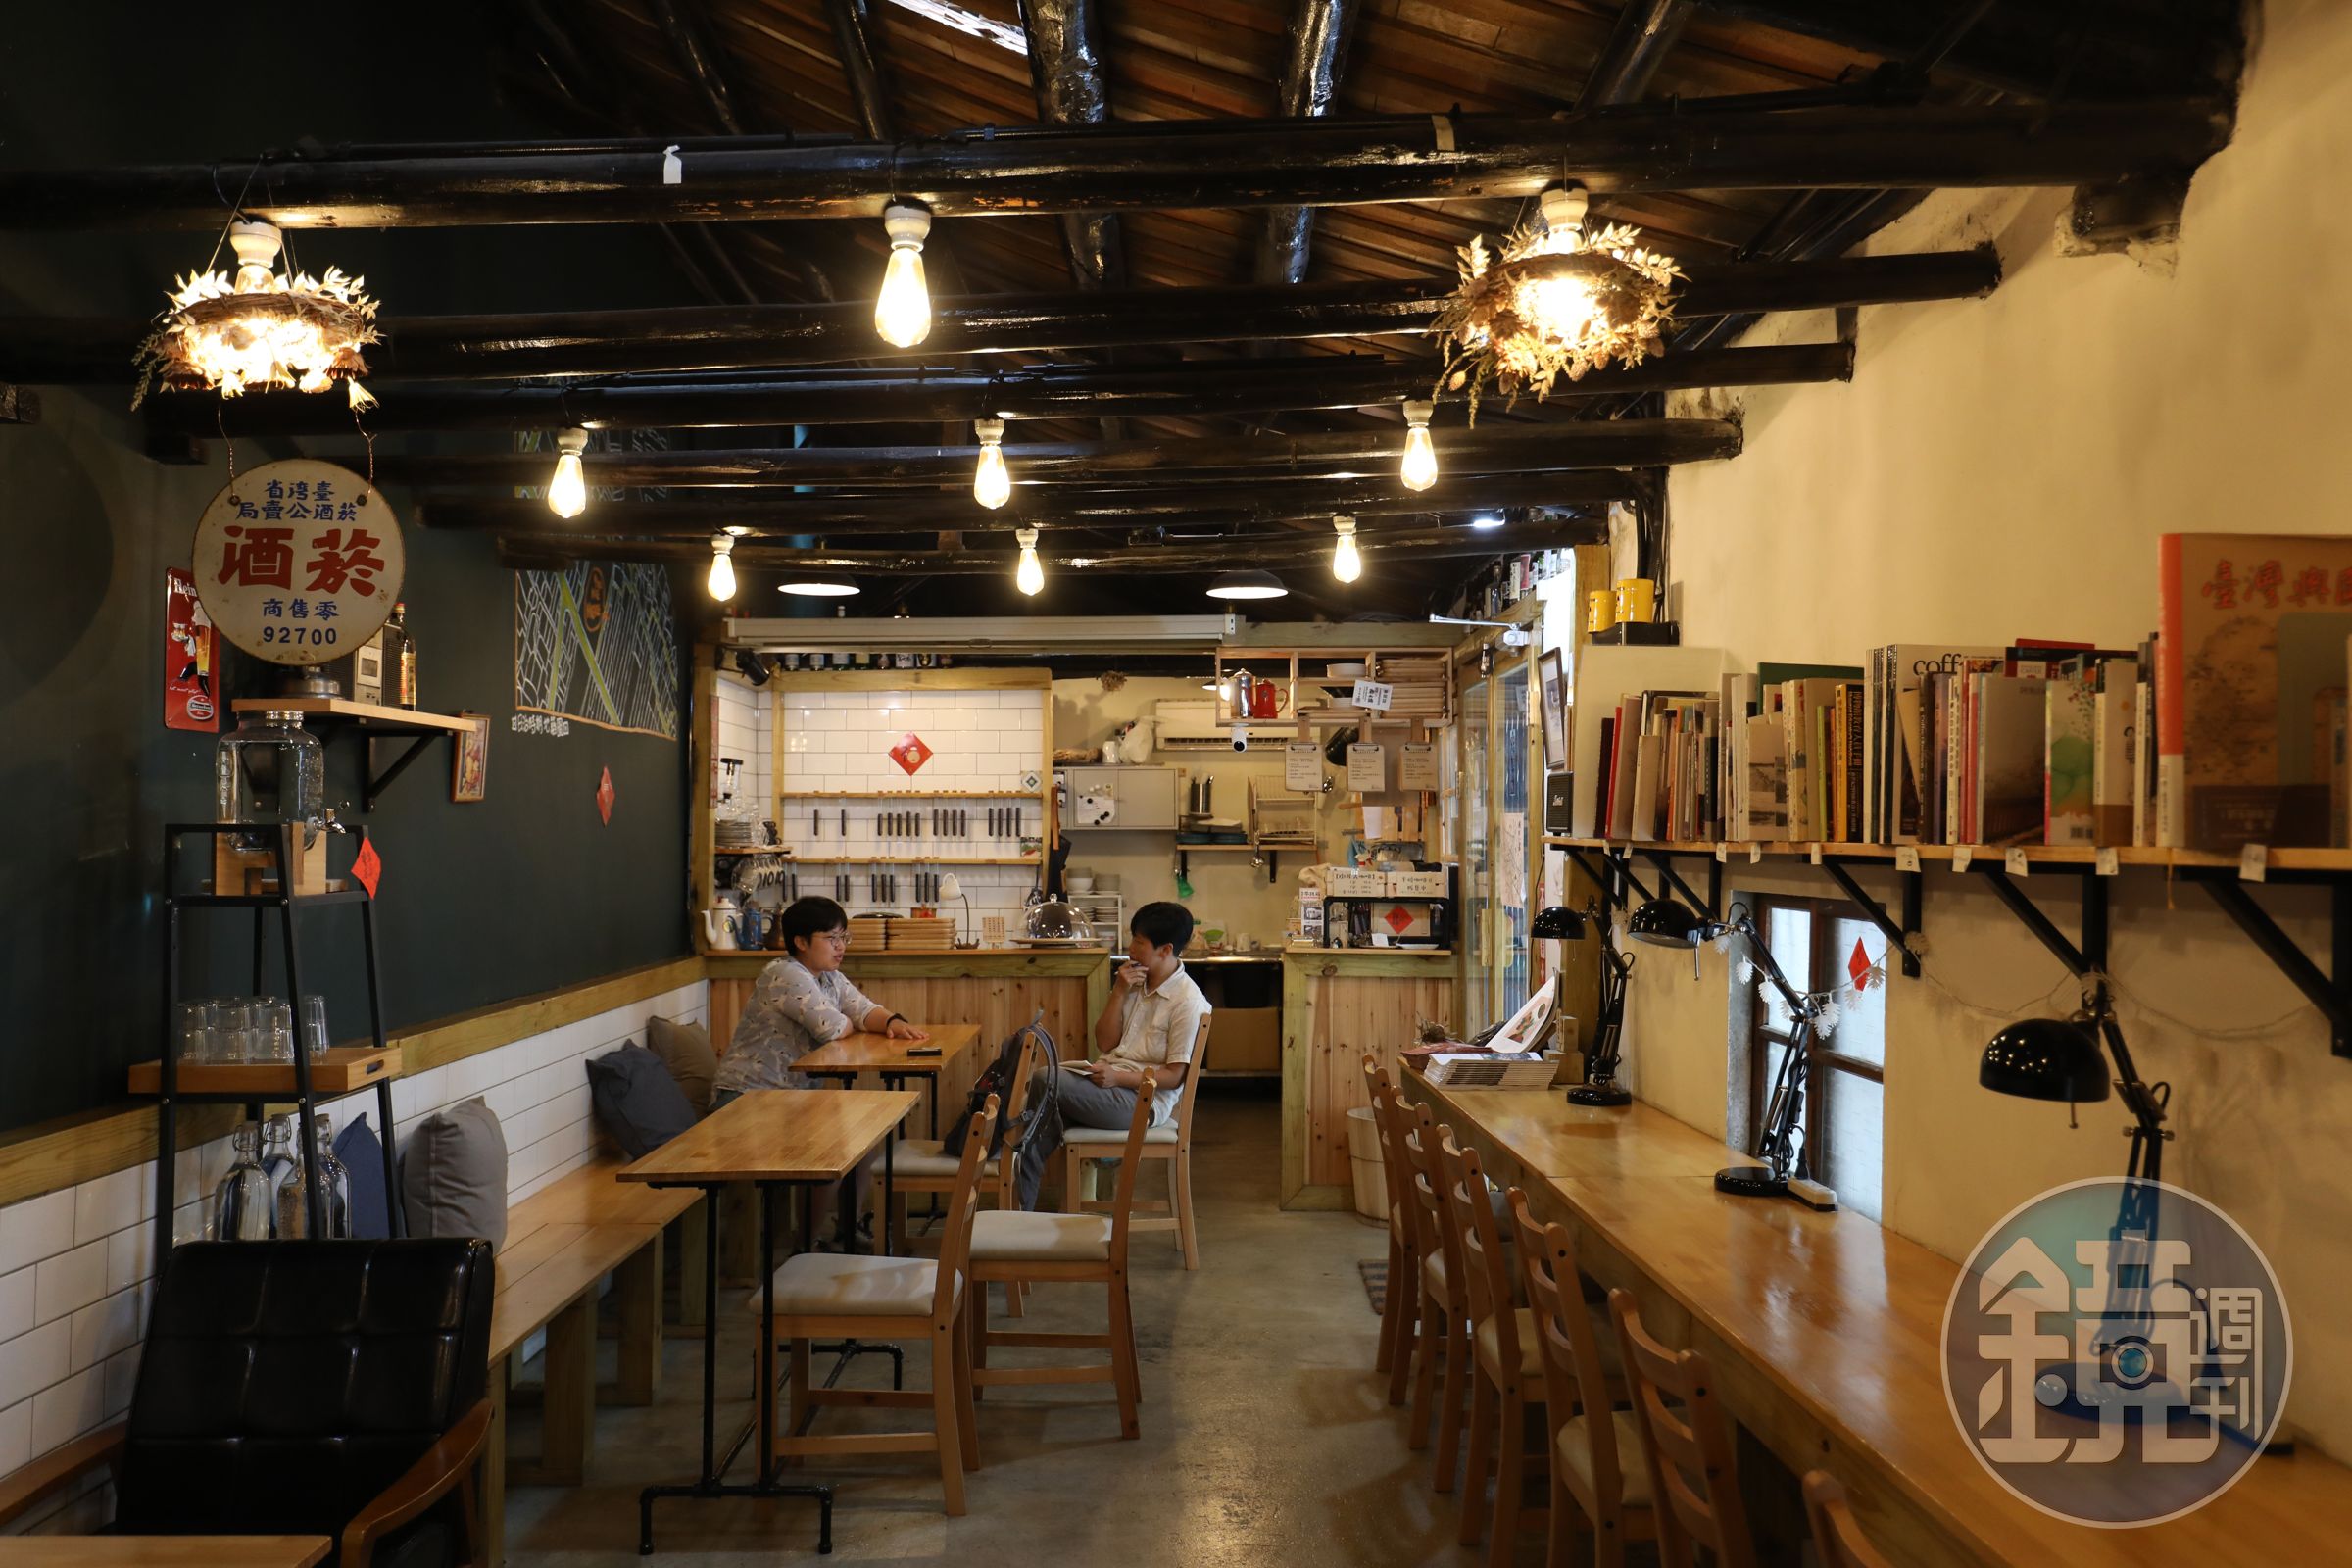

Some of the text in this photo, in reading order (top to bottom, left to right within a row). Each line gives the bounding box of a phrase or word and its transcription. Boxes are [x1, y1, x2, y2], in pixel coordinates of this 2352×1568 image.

[173, 577, 198, 597] Hein
[263, 626, 337, 645] 92700
[1913, 653, 1964, 676] coff
